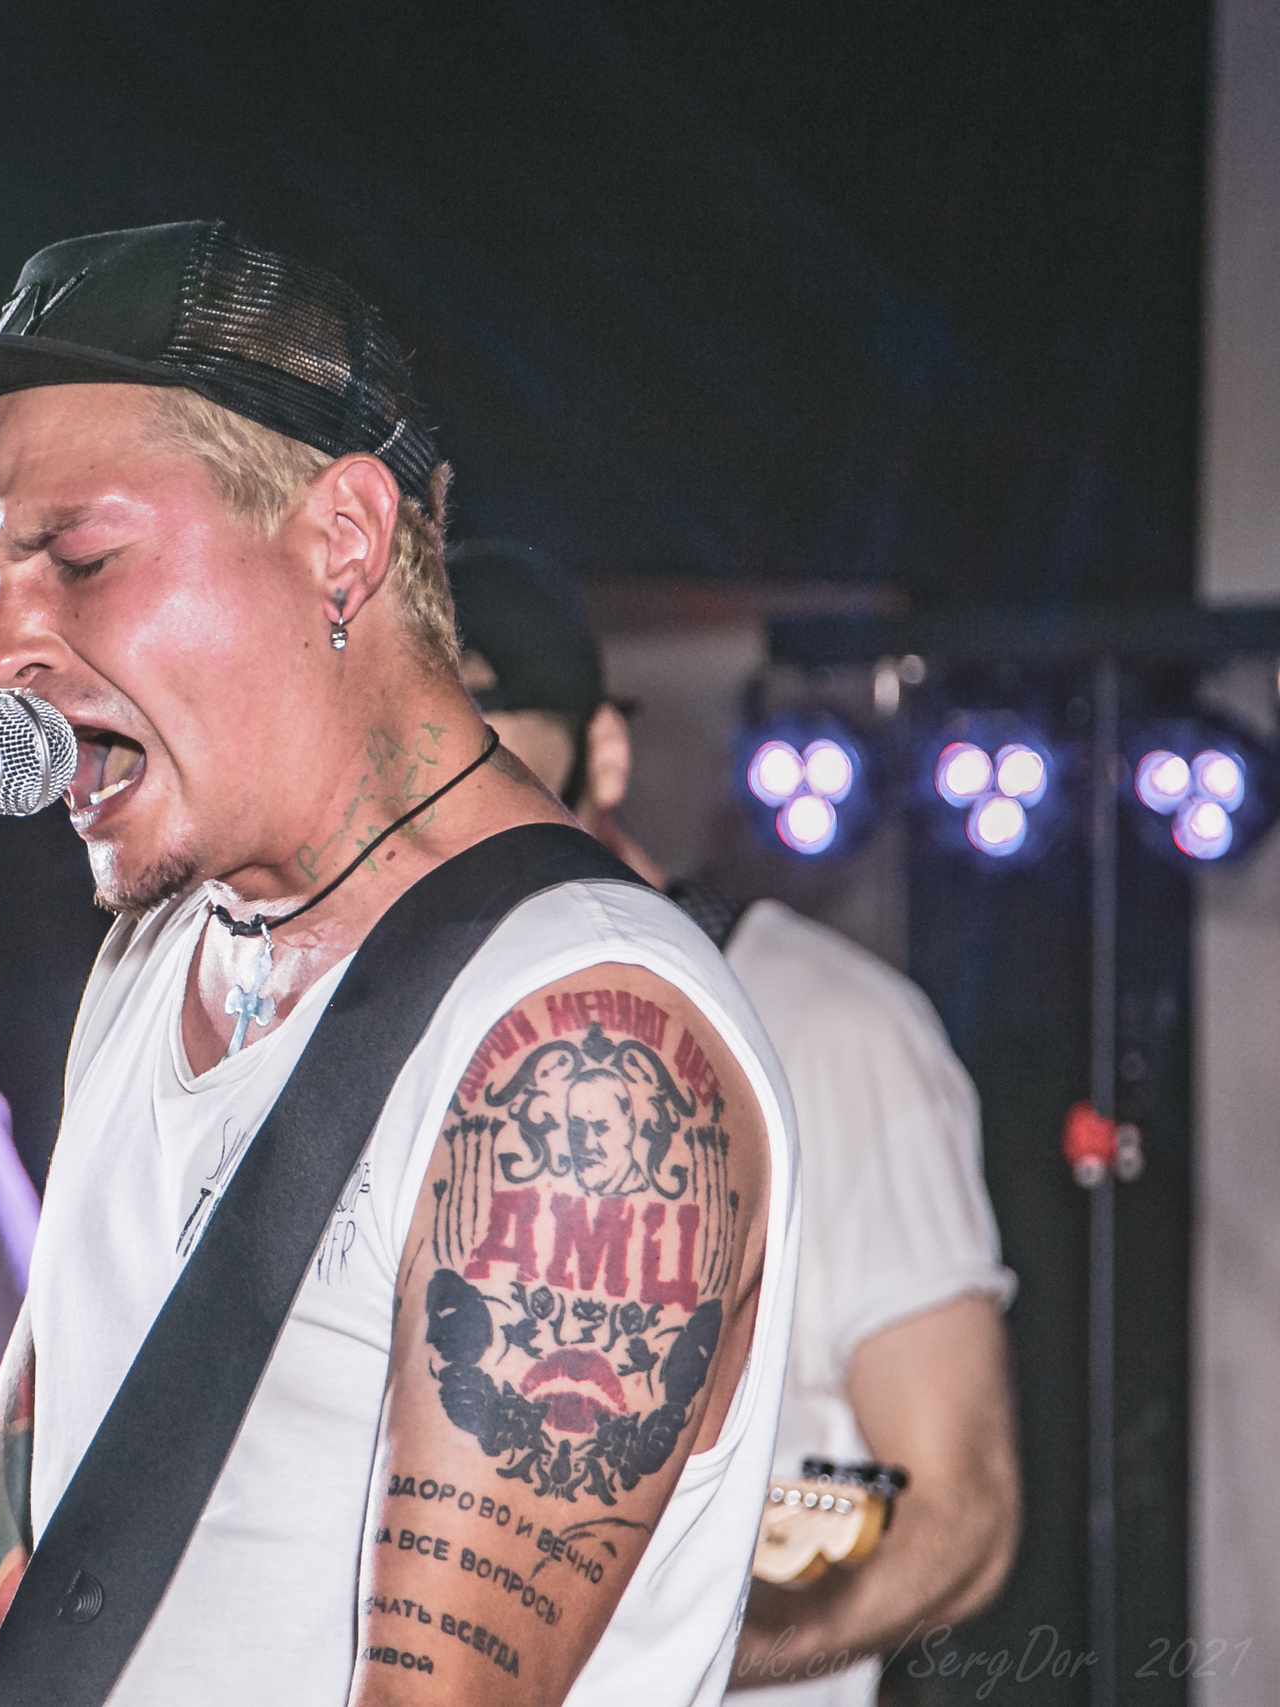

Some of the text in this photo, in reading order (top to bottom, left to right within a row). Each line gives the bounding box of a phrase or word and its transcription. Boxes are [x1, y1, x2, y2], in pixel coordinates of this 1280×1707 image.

[463, 1186, 701, 1314] ДМЦ
[387, 1474, 604, 1584] ЗДОРОВО И ВЕЧНО
[398, 1528, 451, 1561] ВСЕ
[460, 1547, 563, 1625] ВОПРОСЫ
[440, 1613, 519, 1678] ВСЕГДА
